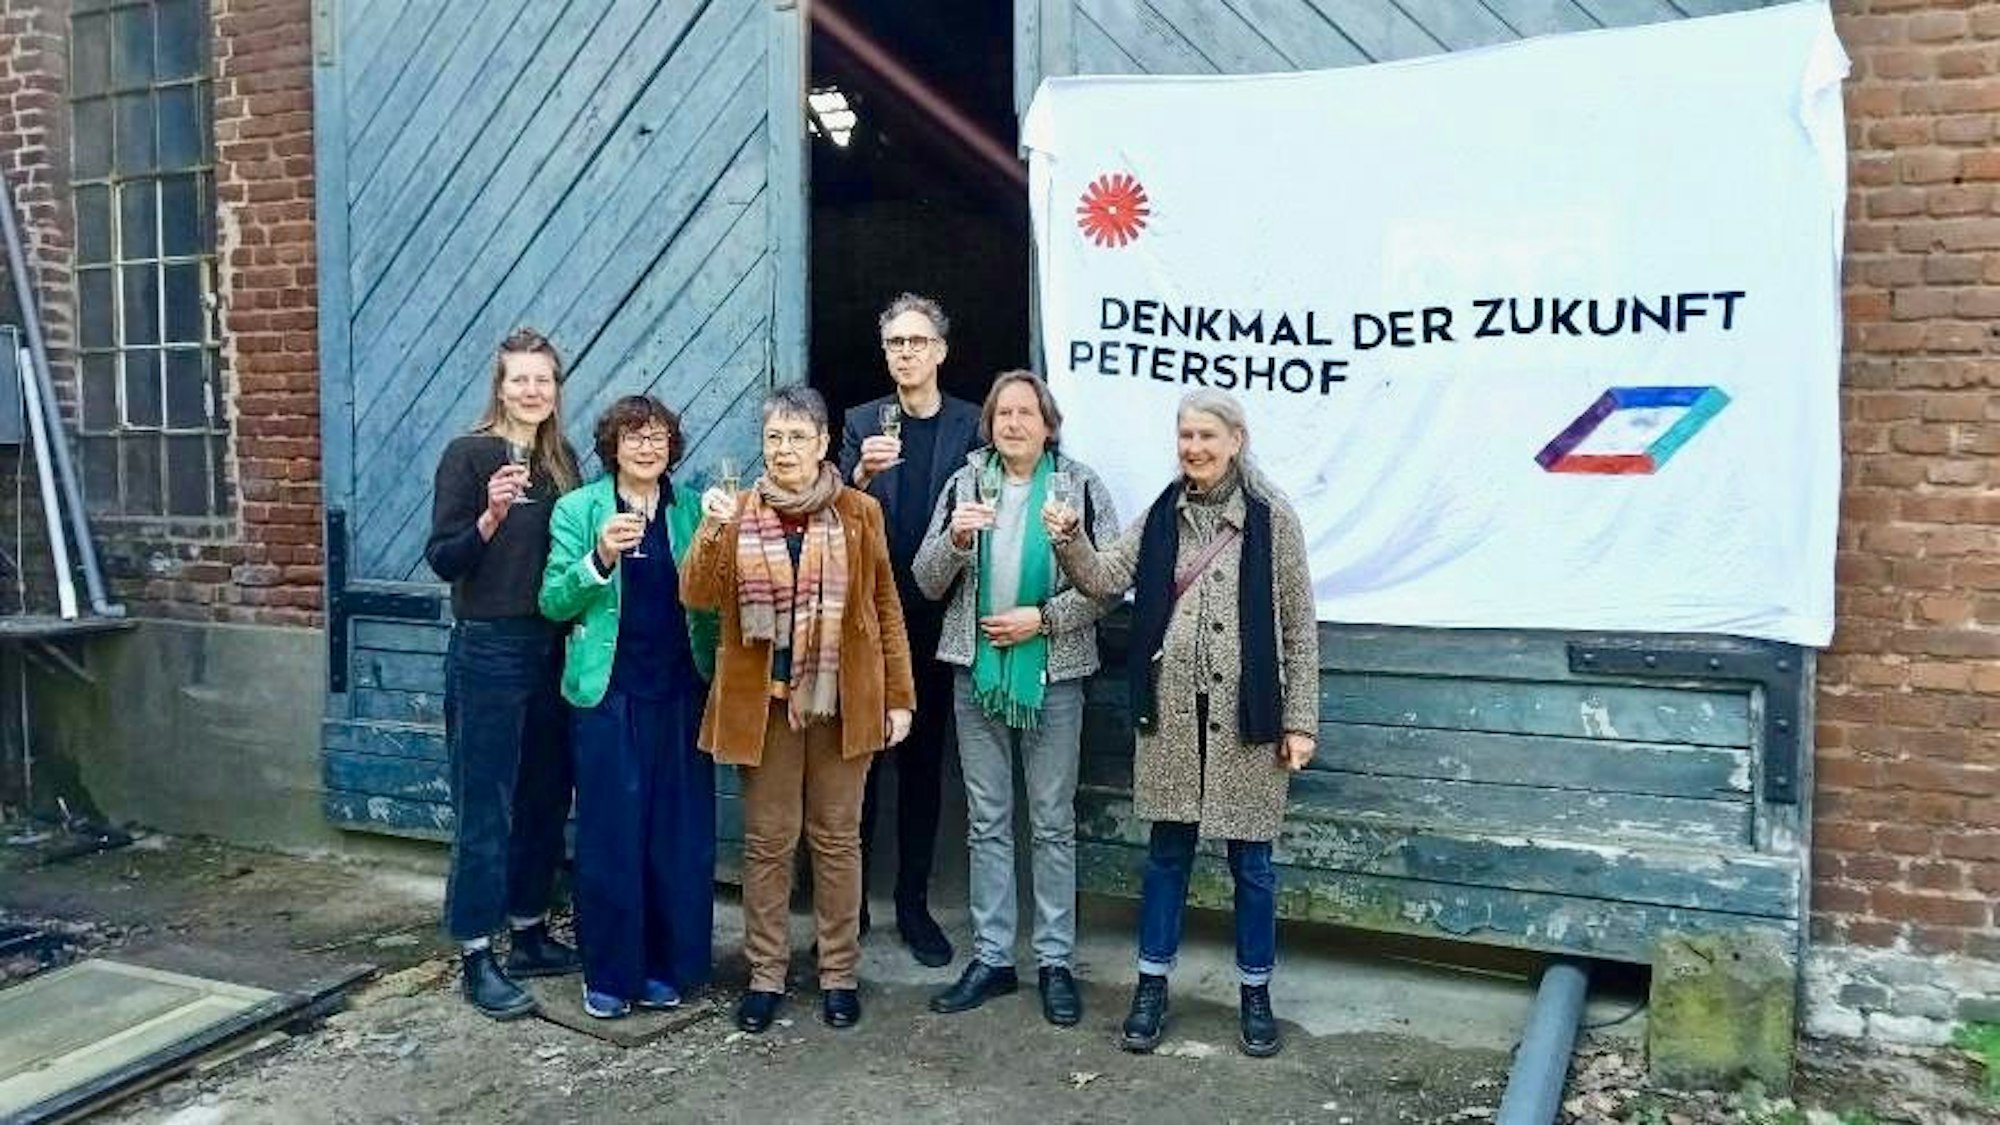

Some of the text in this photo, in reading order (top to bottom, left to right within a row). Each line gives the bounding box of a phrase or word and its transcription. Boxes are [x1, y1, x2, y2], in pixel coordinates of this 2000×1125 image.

[1100, 290, 1746, 351] DENKMAL DER ZUKUNFT
[1069, 340, 1350, 396] PETERSHOF
